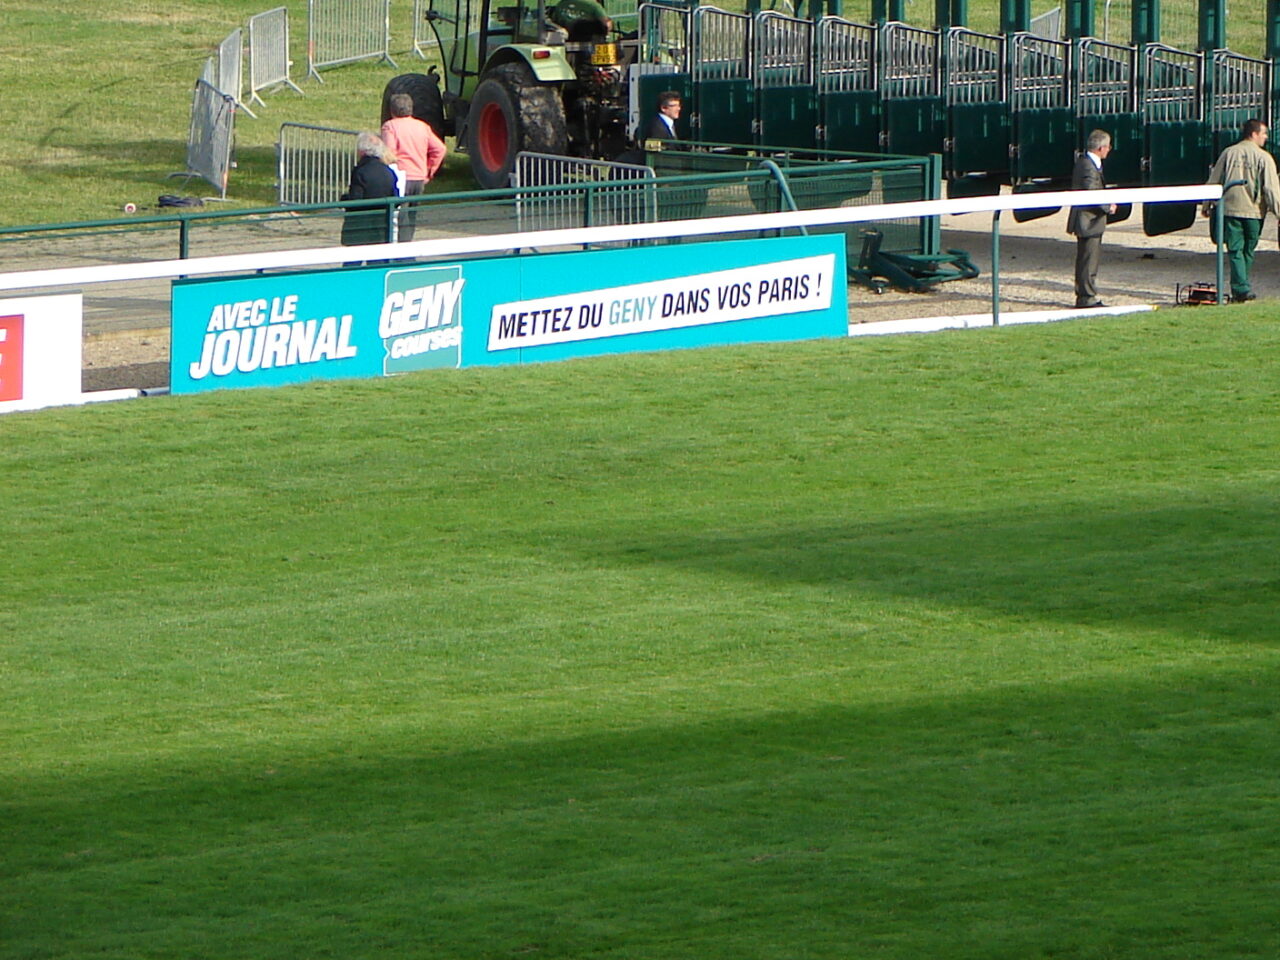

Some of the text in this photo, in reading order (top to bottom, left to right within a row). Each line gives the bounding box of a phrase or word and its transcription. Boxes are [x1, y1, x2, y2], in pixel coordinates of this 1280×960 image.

[207, 295, 299, 332] AVEC LE
[379, 278, 466, 339] GENY
[498, 306, 573, 340] METTEZ
[578, 302, 604, 329] DU
[608, 295, 657, 326] GENY
[660, 287, 711, 318] DANS
[717, 282, 752, 311] VOS
[757, 274, 810, 306] PARIS
[189, 314, 358, 380] JOURNAL
[390, 326, 463, 360] courses
